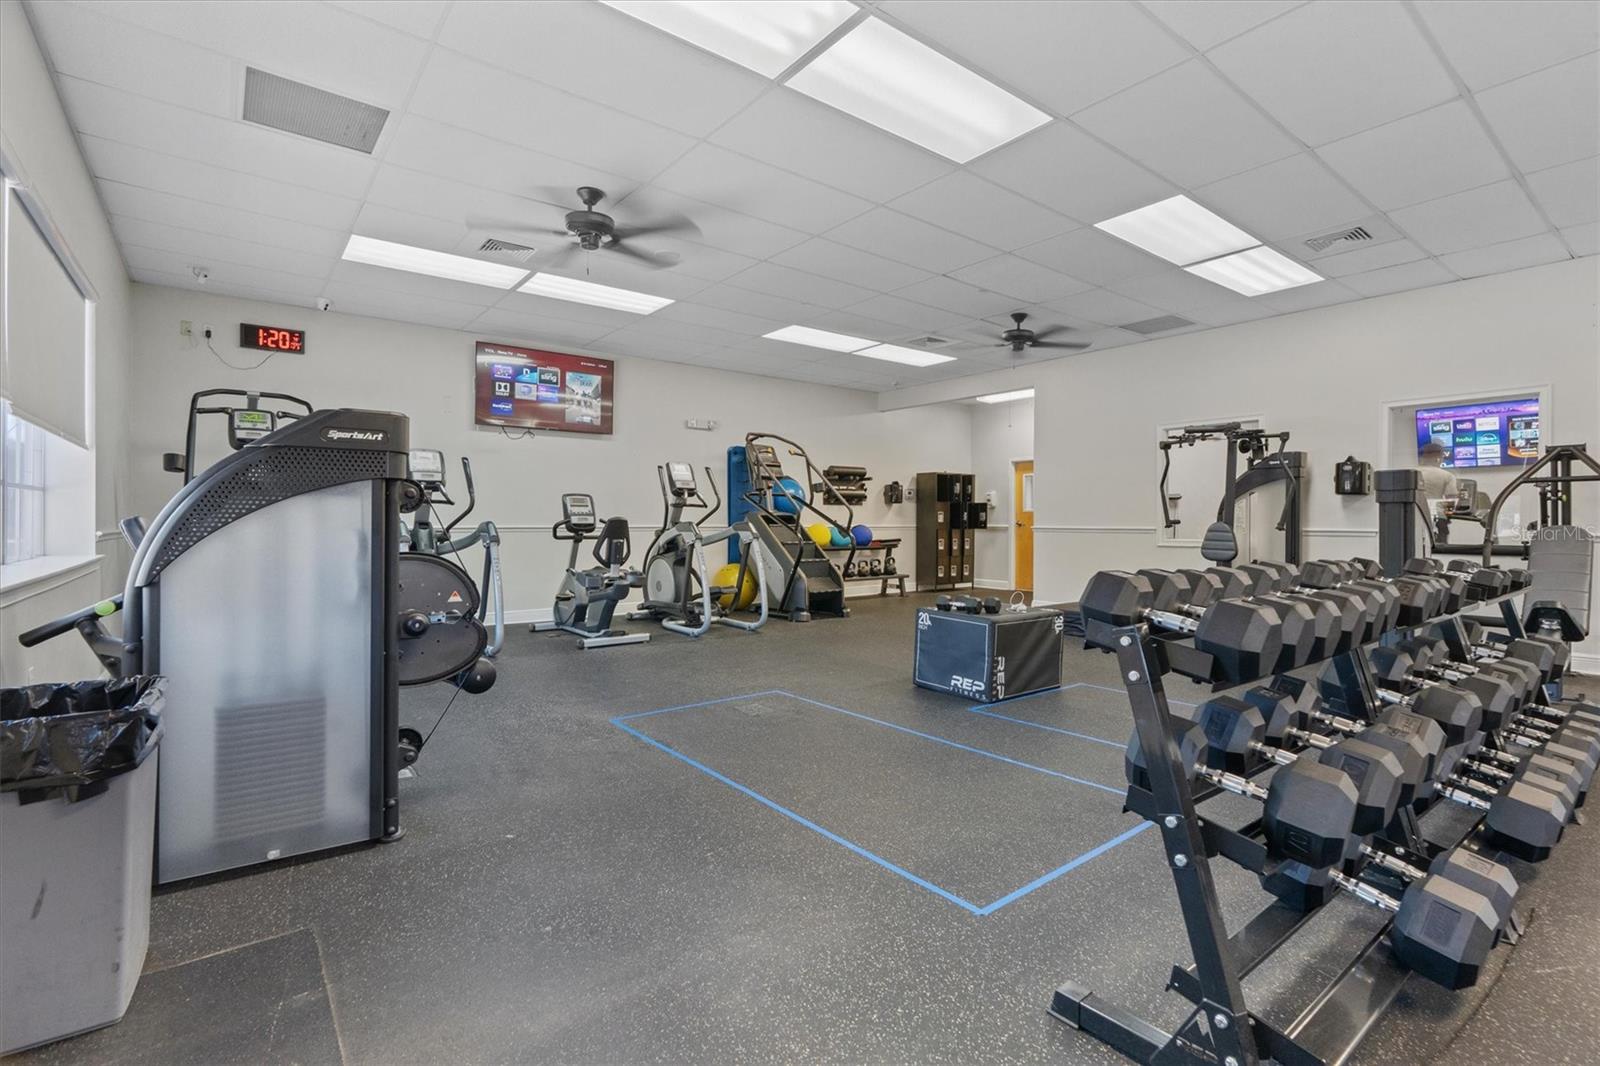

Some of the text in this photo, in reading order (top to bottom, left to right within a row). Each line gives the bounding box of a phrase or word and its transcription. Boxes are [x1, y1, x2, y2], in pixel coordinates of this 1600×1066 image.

[258, 328, 290, 349] 1:20
[327, 430, 384, 440] SportsArt
[918, 612, 930, 625] 20
[1054, 615, 1064, 630] 30
[950, 674, 985, 692] REP
[997, 656, 1006, 700] REP
